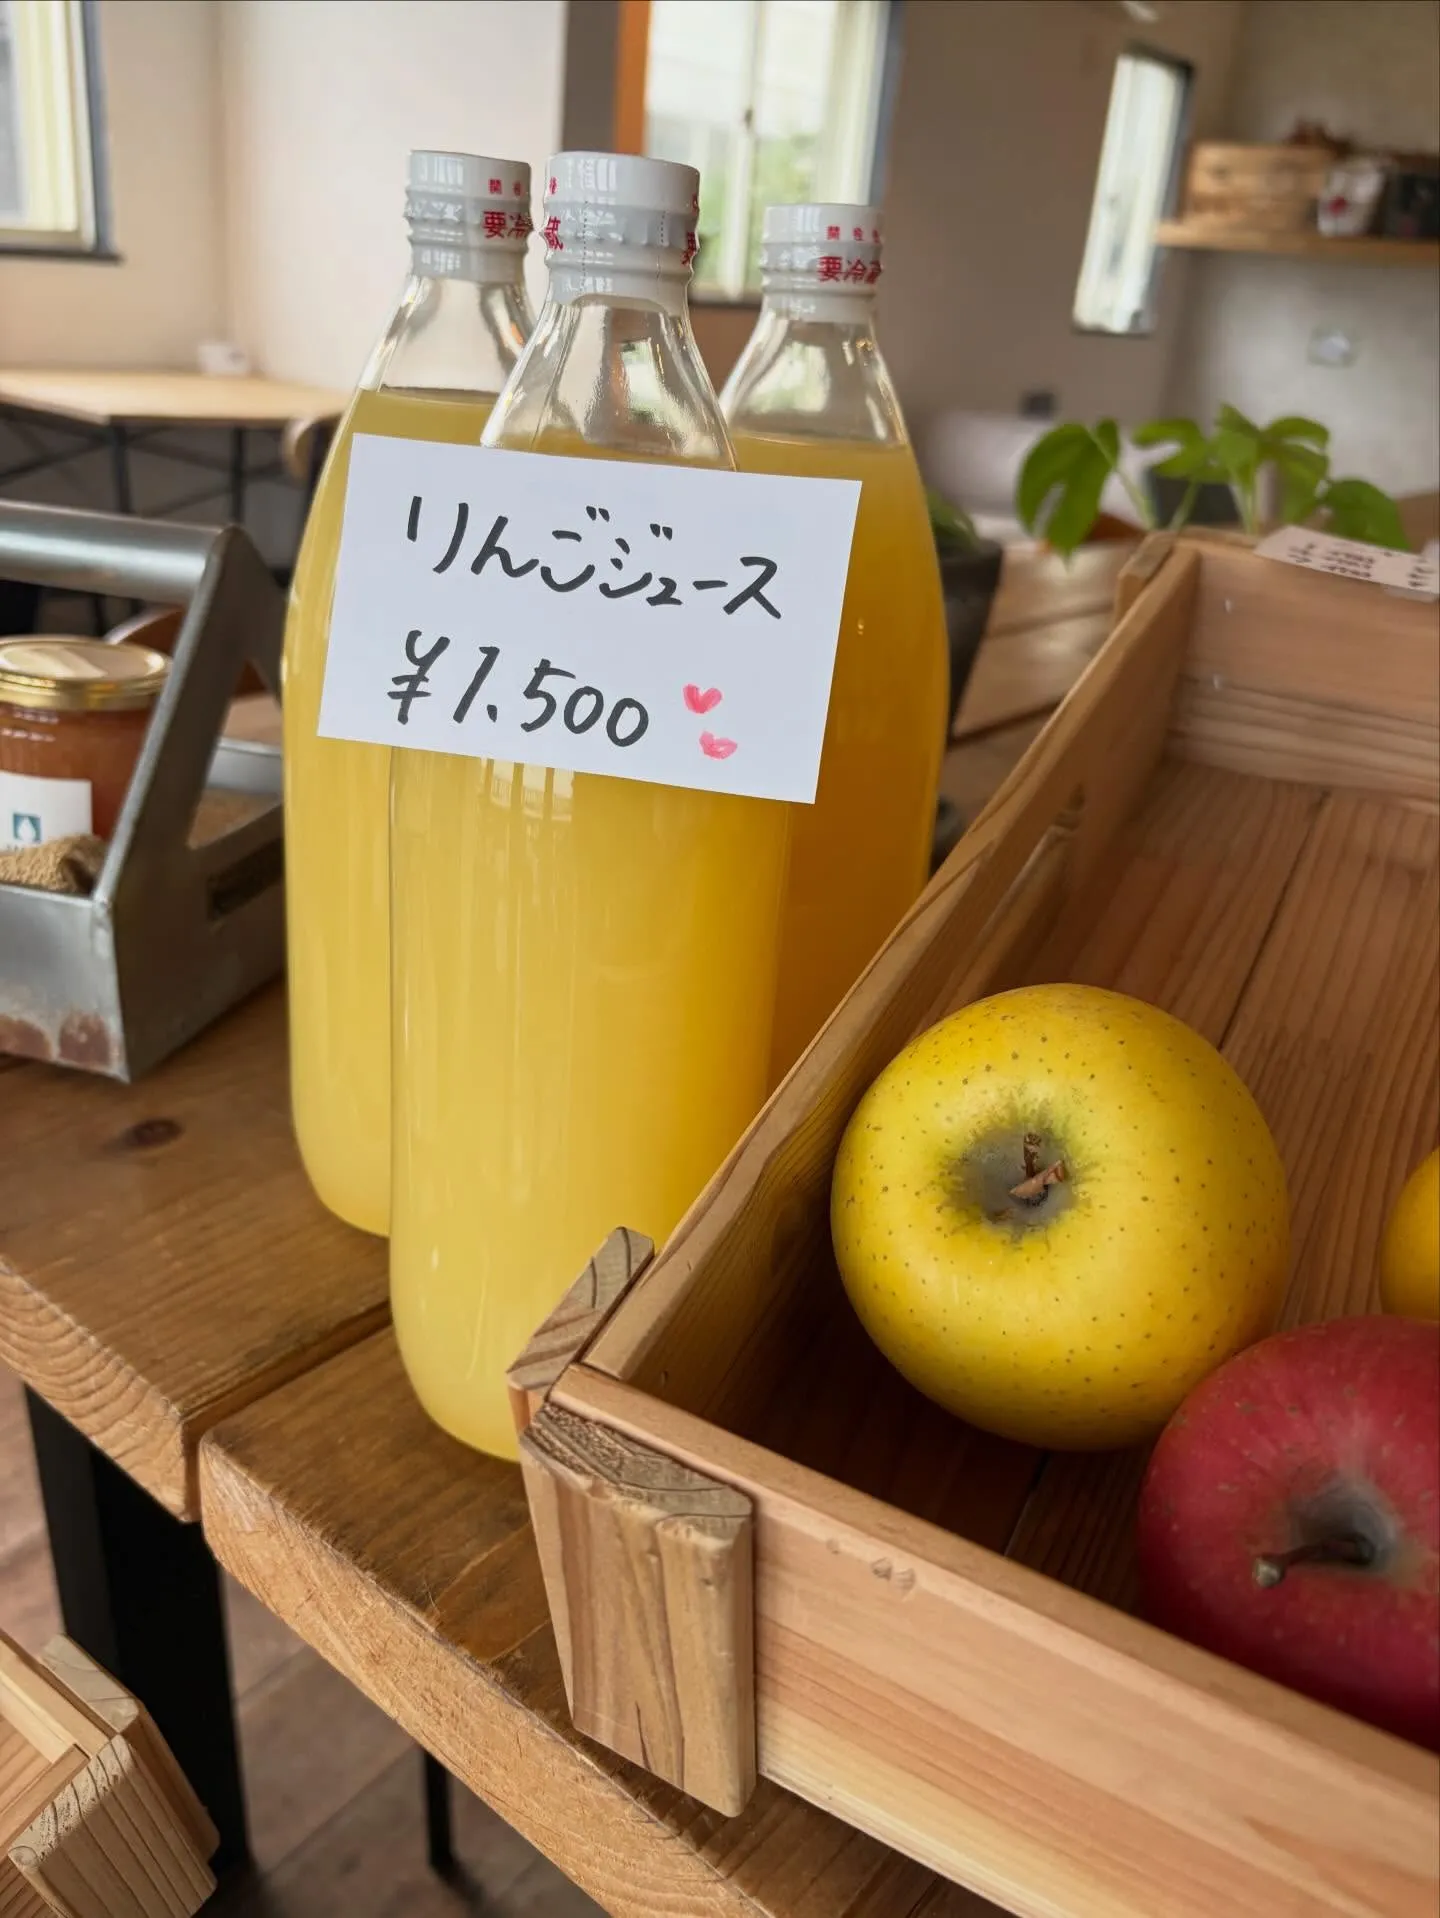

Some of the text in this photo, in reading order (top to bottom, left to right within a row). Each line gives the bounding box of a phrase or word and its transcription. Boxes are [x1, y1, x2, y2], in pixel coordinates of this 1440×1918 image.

[406, 495, 782, 620] りんごジュース
